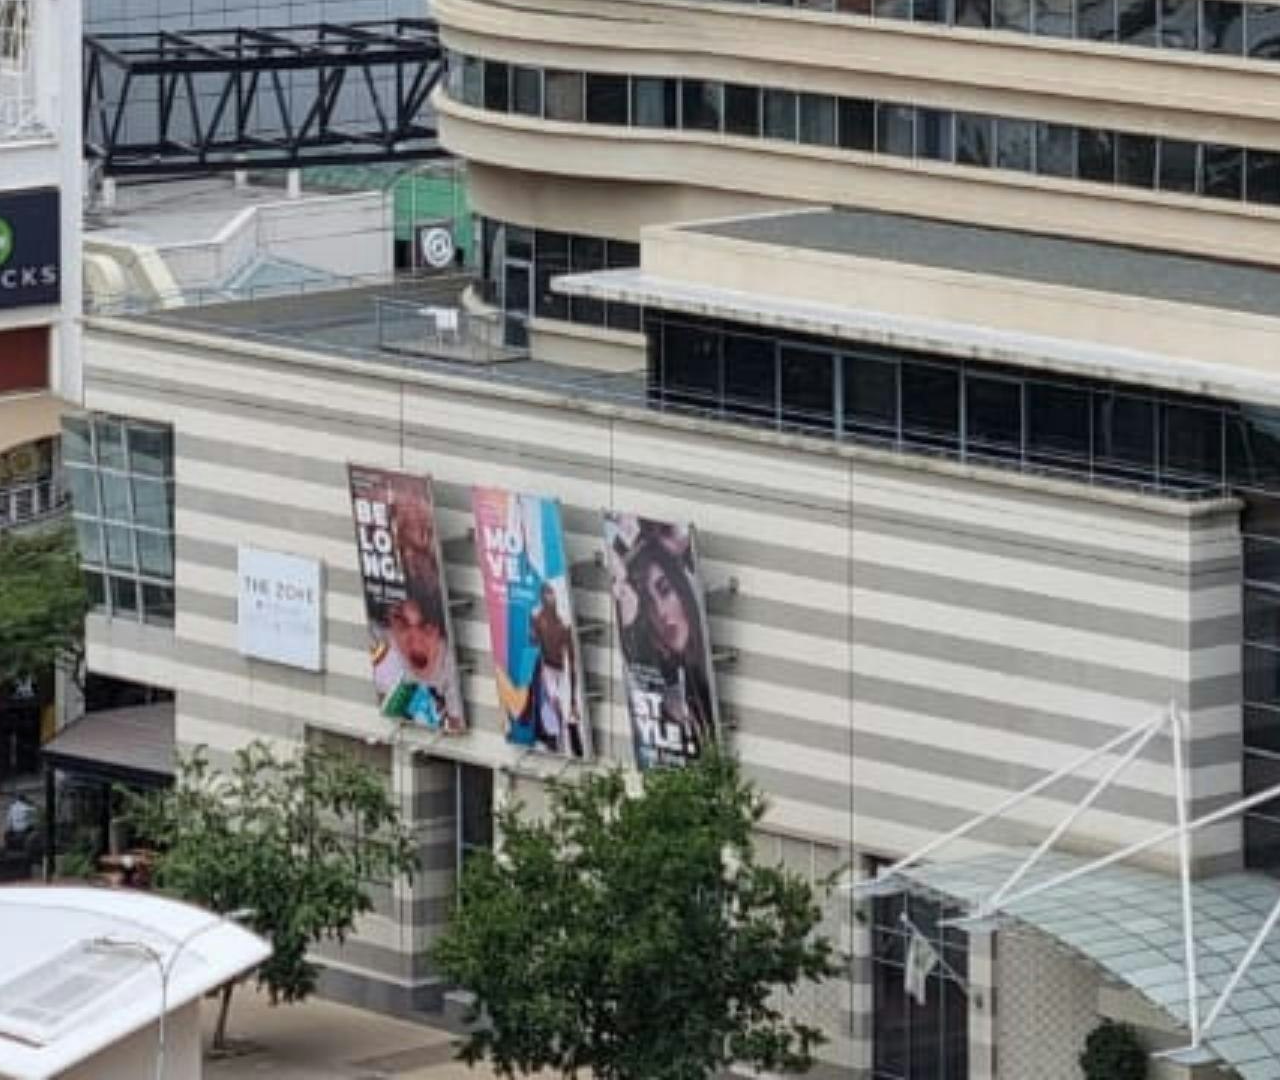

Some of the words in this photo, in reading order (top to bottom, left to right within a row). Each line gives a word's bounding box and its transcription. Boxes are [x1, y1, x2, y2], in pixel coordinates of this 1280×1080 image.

[359, 525, 393, 554] LO
[483, 525, 521, 554] MO
[632, 689, 662, 719] ST
